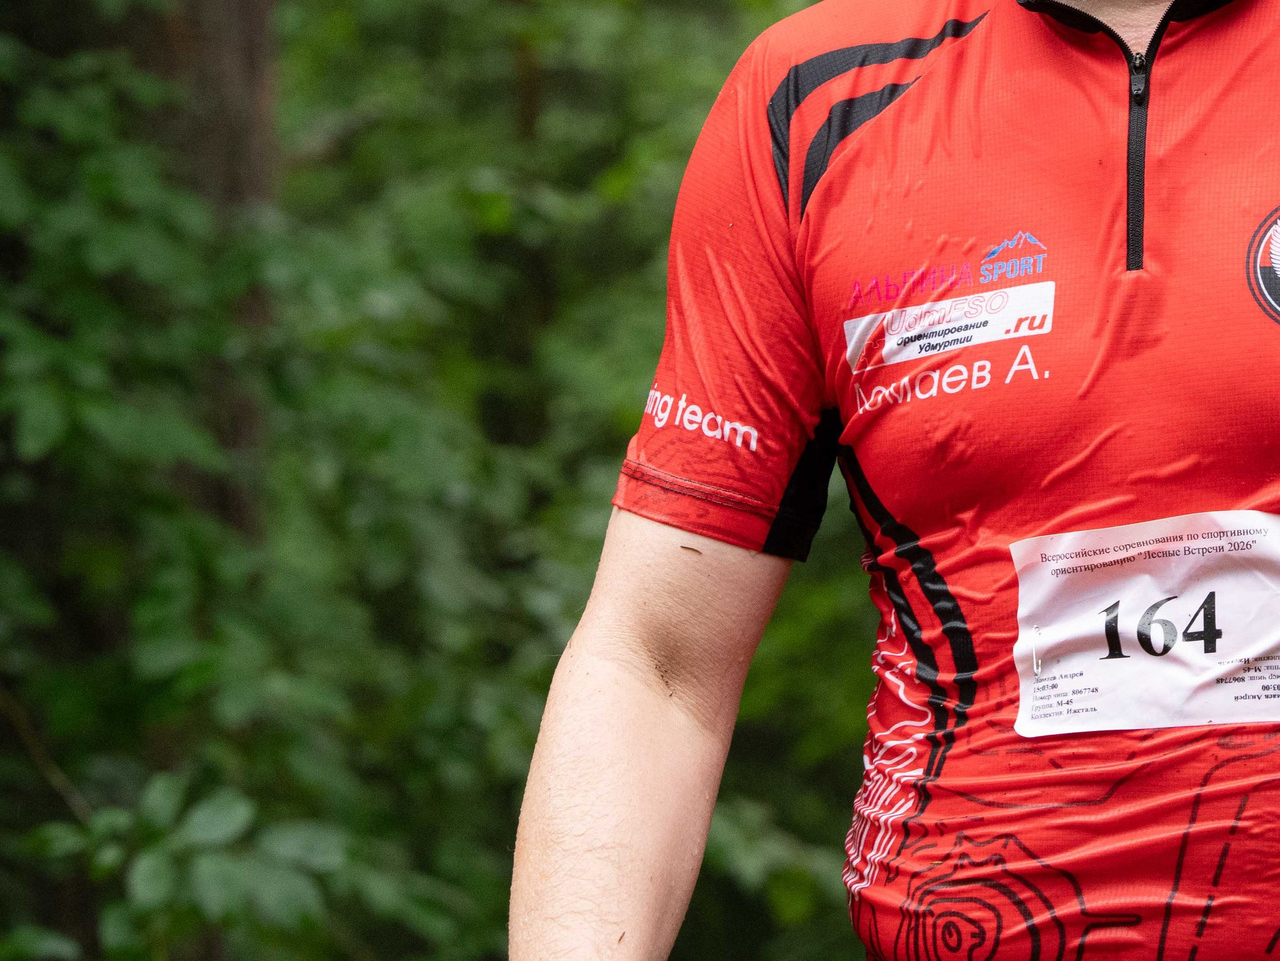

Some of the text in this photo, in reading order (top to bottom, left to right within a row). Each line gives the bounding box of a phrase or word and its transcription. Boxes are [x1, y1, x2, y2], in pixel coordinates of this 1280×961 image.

[980, 254, 1047, 283] SPORT
[886, 291, 1009, 336] UdmFSO
[1004, 313, 1048, 335] .ru
[918, 334, 973, 354] Удмуртии
[1005, 344, 1050, 384] А.
[675, 393, 758, 452] team
[1040, 527, 1270, 564] Всероссийские соревнования по спортивному
[1050, 555, 1136, 578] ориентированию
[1183, 544, 1225, 557] Встречи
[1227, 540, 1257, 553] 2026"
[1098, 590, 1222, 660] 164
[1071, 687, 1099, 696] 8067748
[1216, 676, 1246, 684] 8067748
[1056, 699, 1074, 707] М-45
[1066, 707, 1098, 715] Ижсталь
